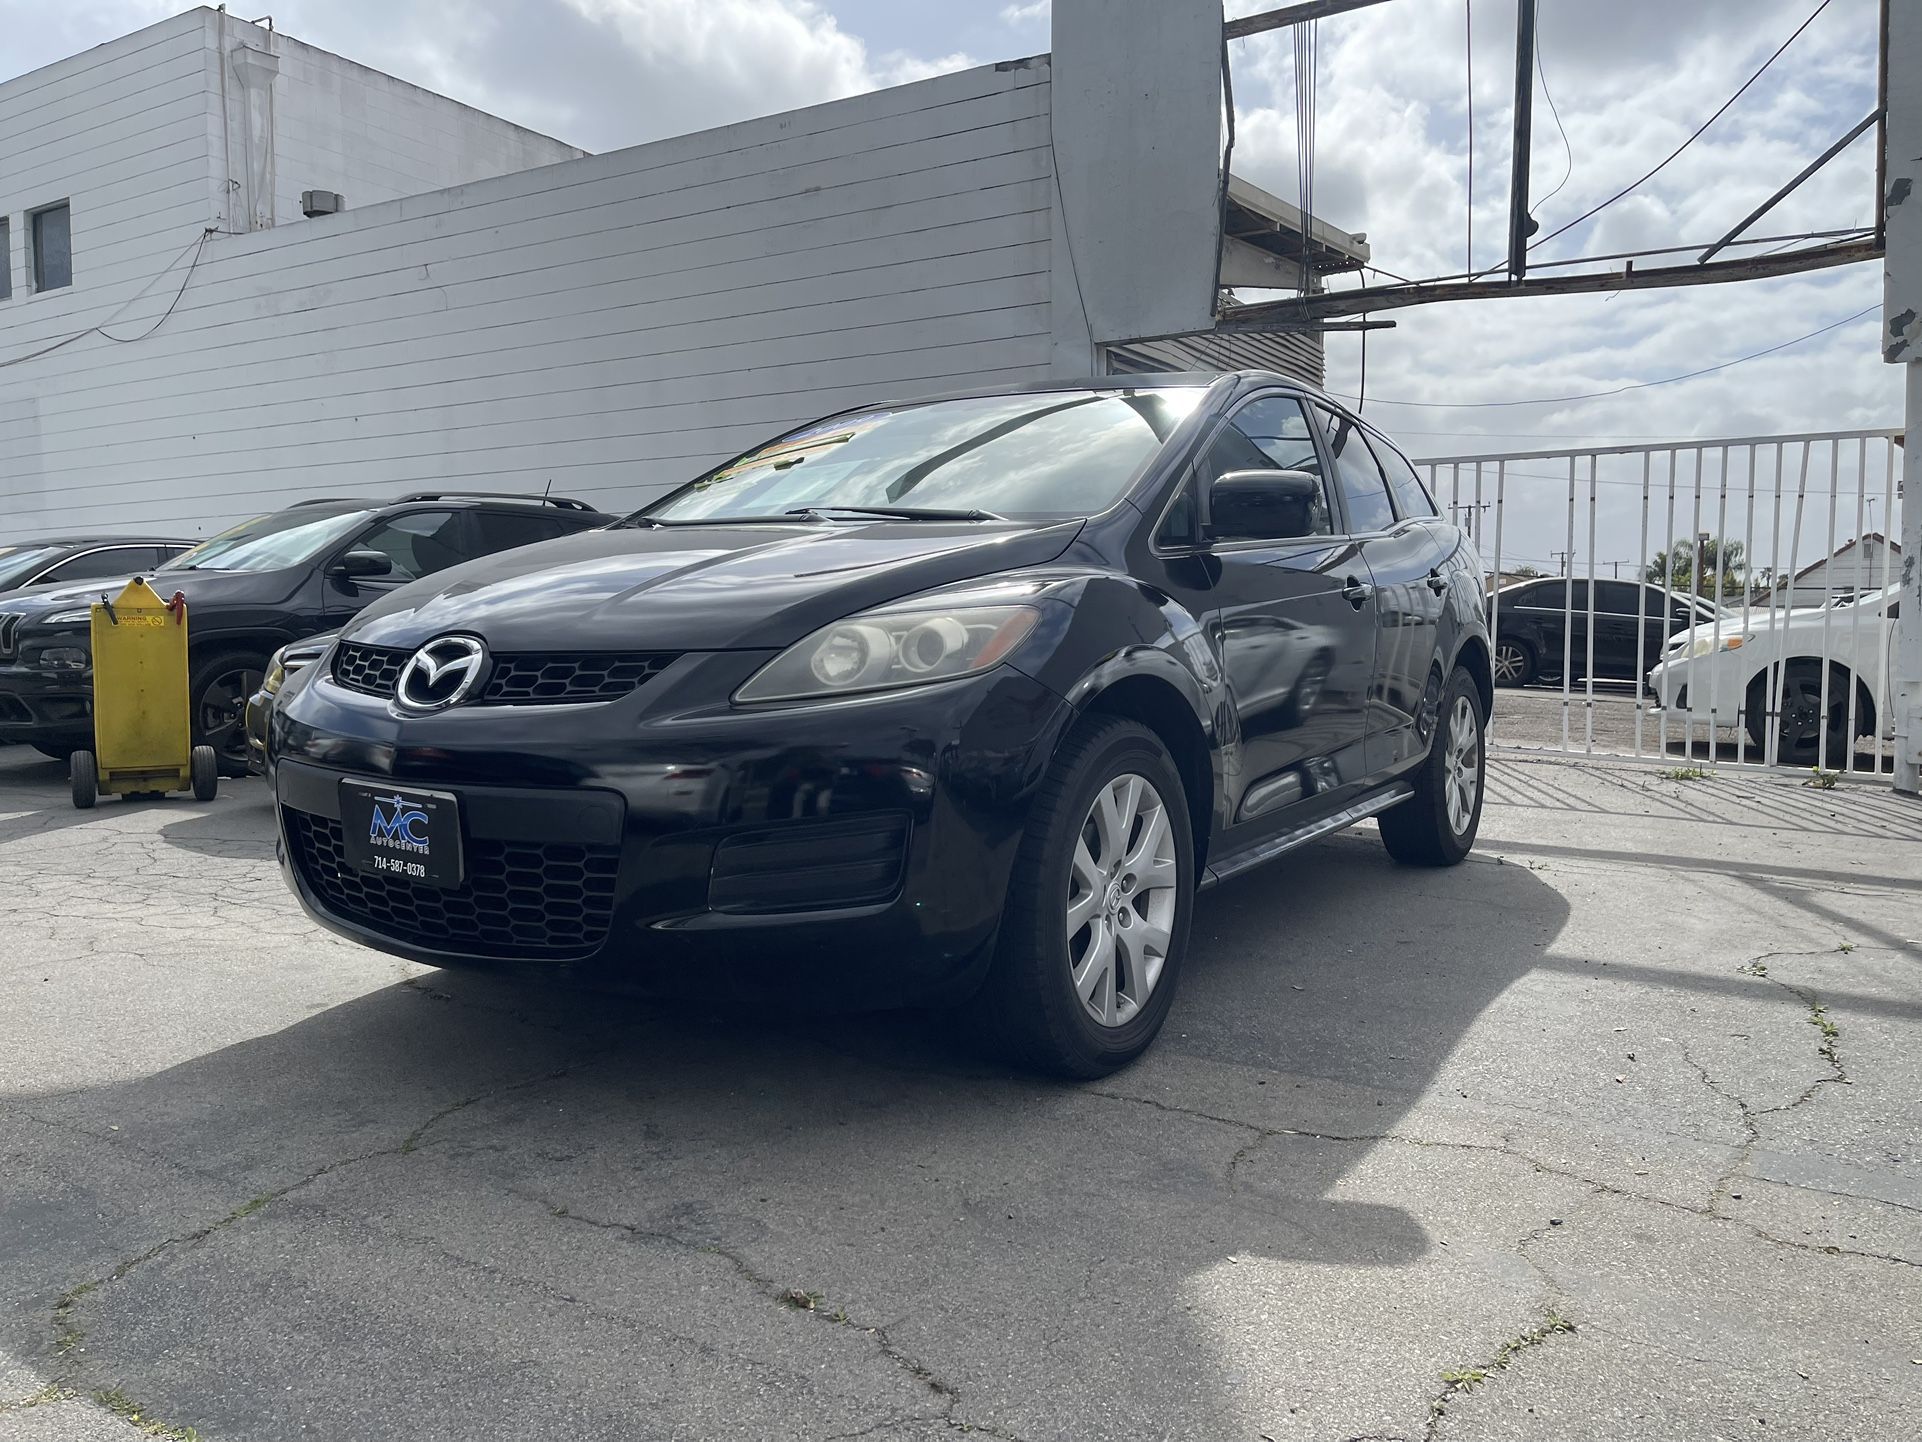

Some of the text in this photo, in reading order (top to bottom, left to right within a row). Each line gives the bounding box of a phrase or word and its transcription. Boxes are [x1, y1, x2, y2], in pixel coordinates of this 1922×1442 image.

[370, 804, 429, 846] MC
[370, 836, 430, 855] AUTOCENTER
[374, 855, 425, 878] 714-587-0378
